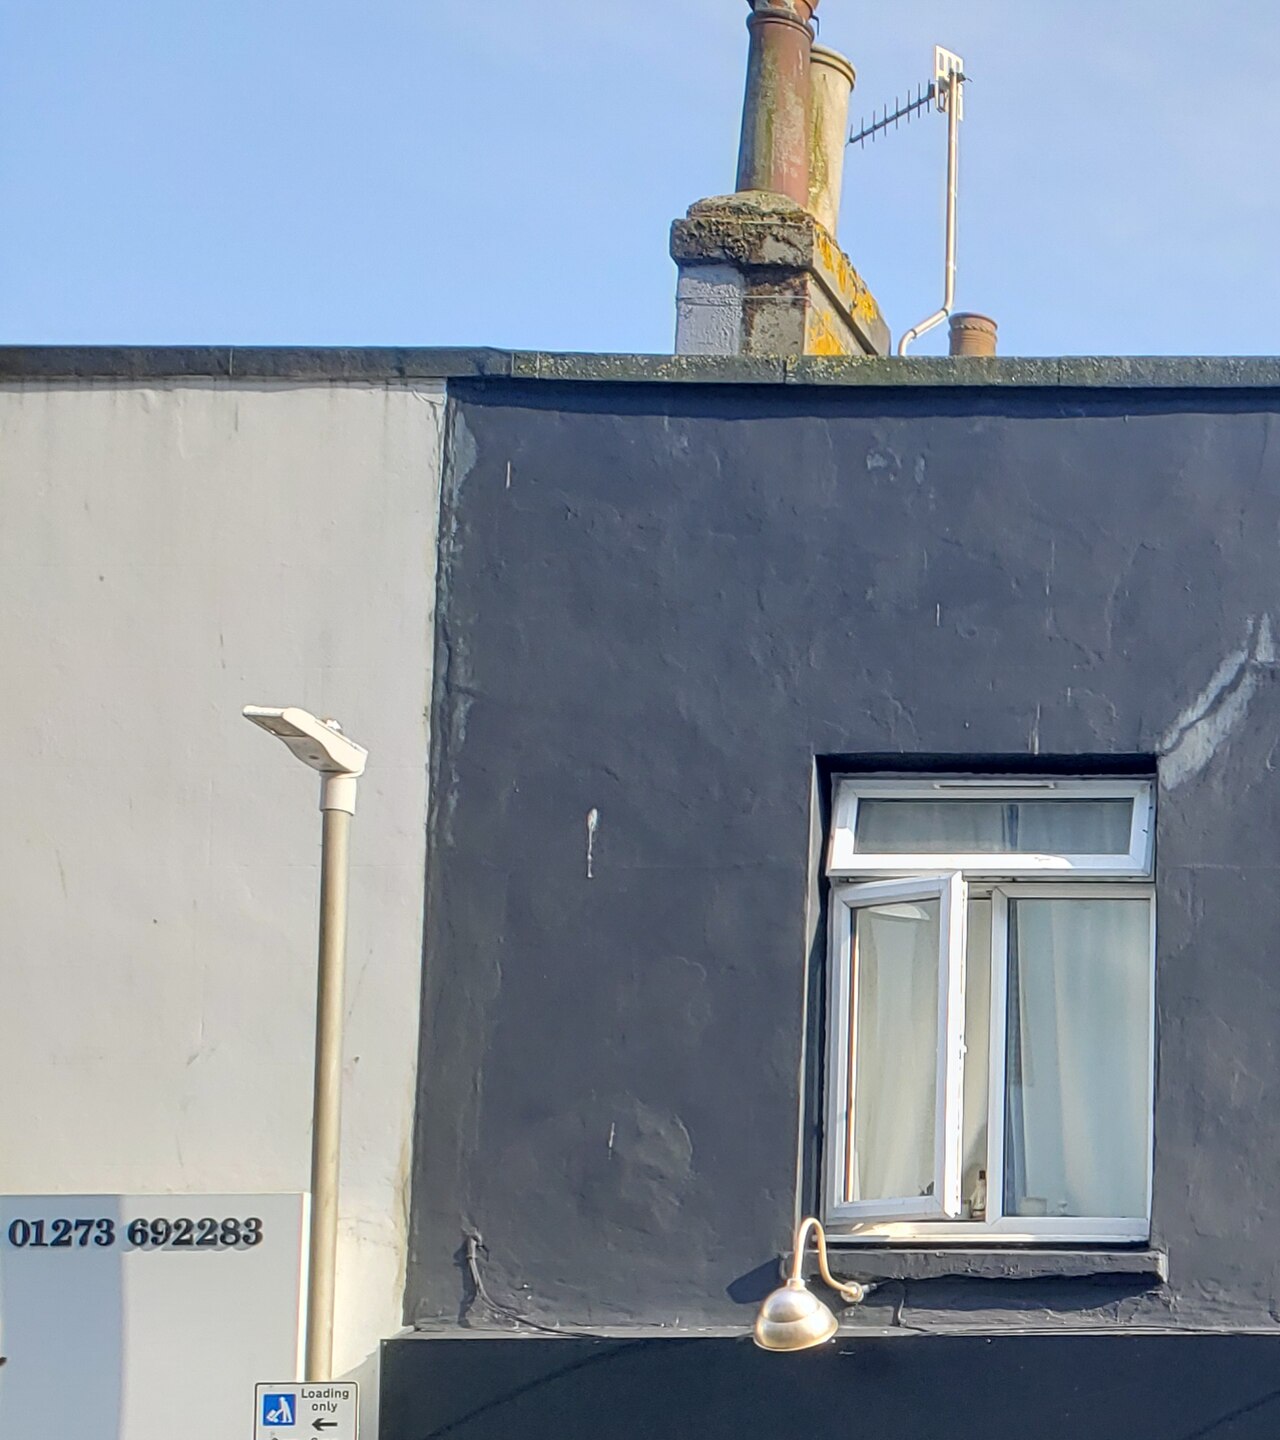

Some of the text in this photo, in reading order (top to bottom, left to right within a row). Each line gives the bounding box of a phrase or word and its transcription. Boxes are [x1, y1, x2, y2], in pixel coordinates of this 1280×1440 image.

[8, 1218, 263, 1247] 01273 692283
[301, 1388, 349, 1400] Loading
[312, 1402, 338, 1412] only
